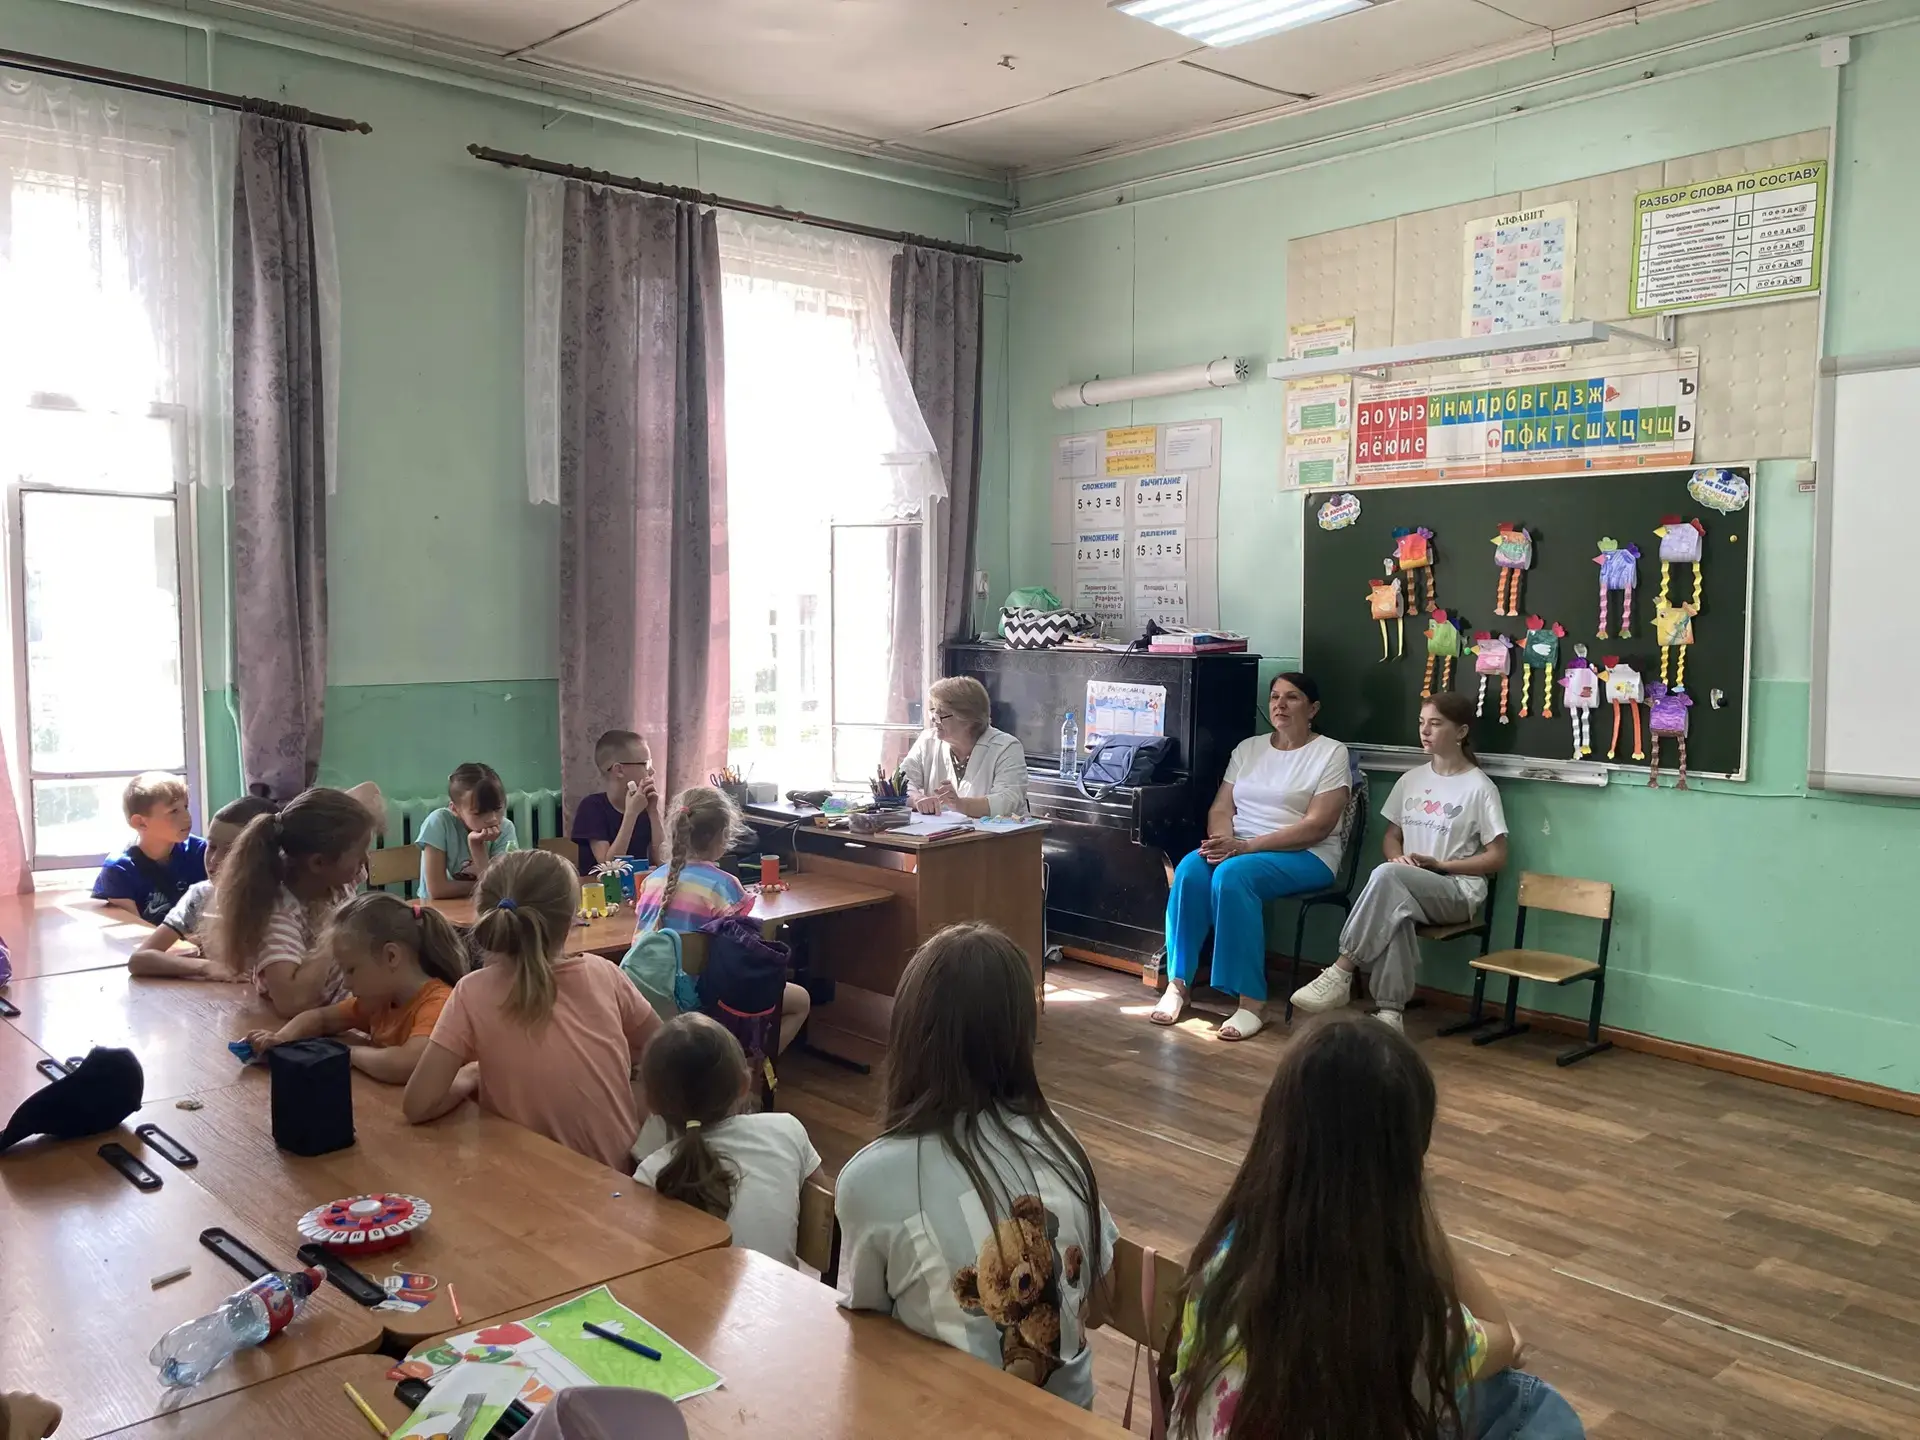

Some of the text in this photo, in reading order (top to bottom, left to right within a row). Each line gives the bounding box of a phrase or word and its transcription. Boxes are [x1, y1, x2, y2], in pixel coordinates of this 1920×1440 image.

[1639, 167, 1821, 208] РАЗБОР СЛОВА ПО СОСТАВУ
[1495, 209, 1545, 227] АЛФАВИТ
[1430, 397, 1439, 418] й
[1444, 402, 1454, 417] н
[1459, 401, 1472, 416] м
[1475, 399, 1485, 414] л
[1490, 396, 1500, 418] р
[1505, 389, 1516, 410] б
[1521, 393, 1532, 409] в
[1539, 392, 1548, 408] г
[1554, 390, 1568, 411] д
[1573, 388, 1584, 406] з
[1588, 387, 1602, 404] ж
[1360, 404, 1425, 428] а о у ы э
[1504, 428, 1515, 445] п
[1519, 423, 1533, 449] ф
[1537, 426, 1547, 443] к
[1555, 425, 1564, 441] т
[1572, 424, 1581, 440] с
[1587, 423, 1601, 439] ш
[1605, 422, 1616, 437] х
[1622, 420, 1635, 440] ц
[1641, 418, 1653, 434] ч
[1657, 416, 1673, 436] щ
[1303, 436, 1332, 446] ГЛАГОЛ
[1359, 435, 1425, 457] я ё ю и е
[1082, 481, 1117, 491] СЛОЖЕНИЕ
[1140, 476, 1182, 487] ВЫЧИТАНИЕ
[1704, 479, 1737, 496] НЕ БУДЕМ
[1077, 499, 1083, 509] 5
[1095, 497, 1101, 508] 3
[1115, 496, 1121, 507] 8
[1137, 493, 1143, 504] 9
[1155, 491, 1161, 502] 4
[1176, 490, 1182, 501] 5
[1080, 533, 1119, 543] УМНОЖЕНИЕ
[1140, 529, 1177, 538] ДЕЛЕНИЕ
[1077, 549, 1082, 560] 6
[1095, 548, 1101, 560] 3
[1112, 548, 1120, 559] 18
[1136, 544, 1146, 556] 15
[1156, 544, 1162, 555] 3
[1176, 543, 1182, 555] 5
[1157, 596, 1163, 605] S
[1178, 596, 1184, 605] b
[1159, 614, 1164, 624] S
[1171, 616, 1176, 624] a
[1179, 616, 1184, 624] a
